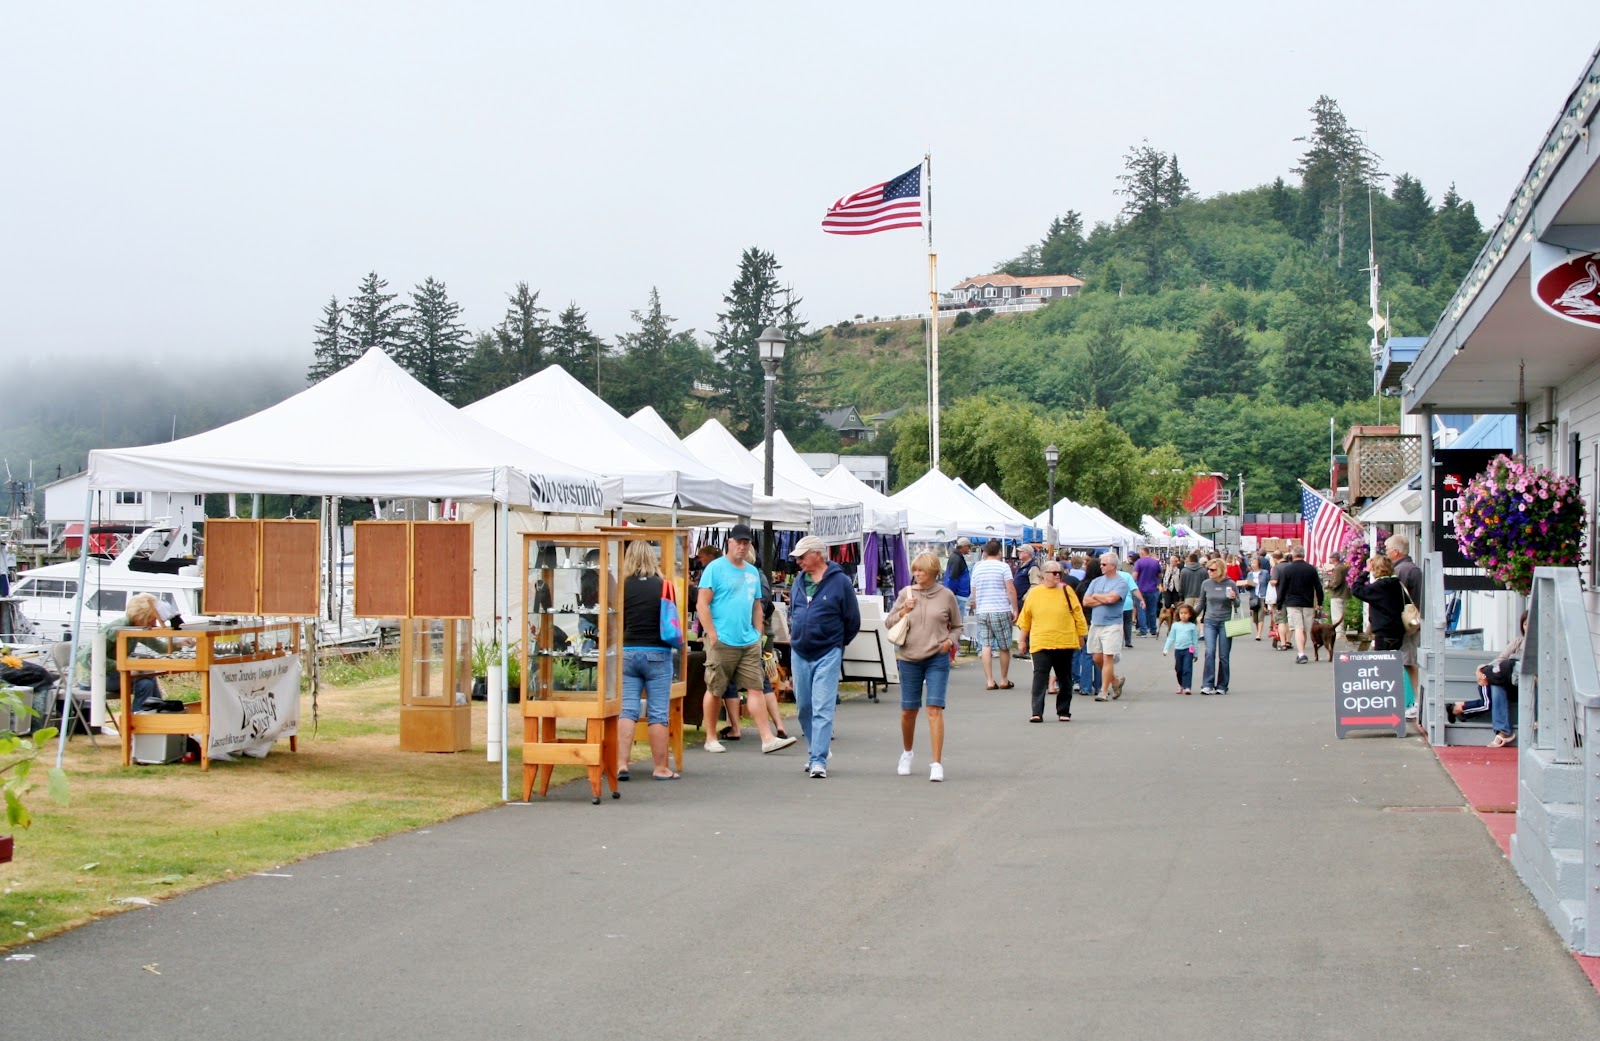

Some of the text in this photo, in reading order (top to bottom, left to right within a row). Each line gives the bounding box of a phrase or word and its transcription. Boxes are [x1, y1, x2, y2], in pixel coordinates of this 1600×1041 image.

[529, 473, 604, 510] Silversmith
[1349, 653, 1397, 661] mariePOWELL
[1357, 665, 1379, 677] art
[1342, 678, 1395, 694] gallery
[1343, 696, 1397, 712] open
